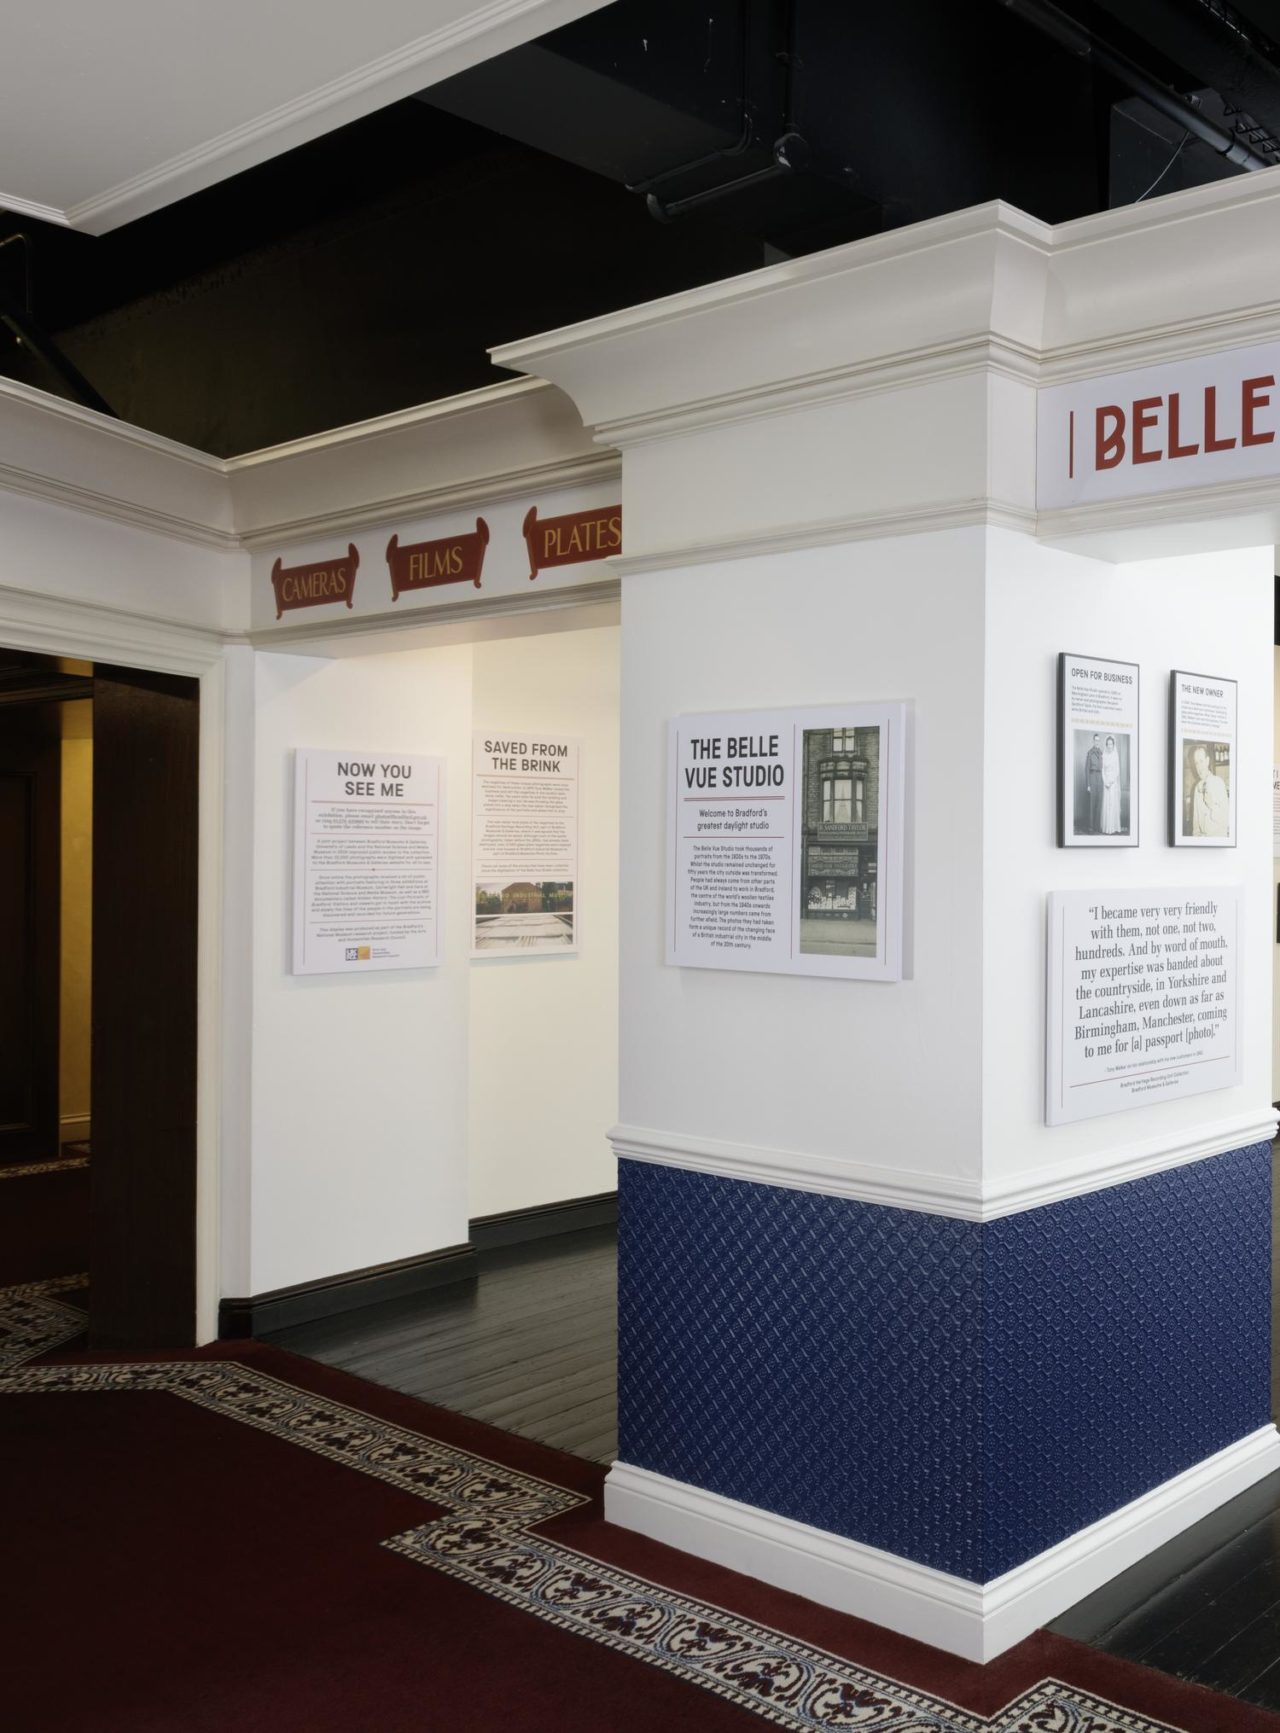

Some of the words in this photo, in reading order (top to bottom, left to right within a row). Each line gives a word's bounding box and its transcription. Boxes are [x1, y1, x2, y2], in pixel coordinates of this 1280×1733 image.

[1097, 377, 1274, 468] BELLE
[543, 516, 622, 558] PLATES
[409, 546, 463, 582] FILMS
[282, 567, 346, 602] CAMERAS
[1071, 668, 1089, 679] OPEN
[1090, 670, 1102, 681] FOR
[1103, 672, 1133, 685] BUSINESS
[1181, 684, 1192, 693] THE
[1193, 686, 1204, 695] NEW
[1205, 687, 1224, 698] OWNER
[484, 740, 527, 754] SAVED
[532, 744, 568, 757] FROM
[690, 738, 721, 760] THE
[727, 735, 779, 758] BELLE
[337, 762, 375, 777] NOW
[380, 764, 412, 779] YOU
[492, 758, 517, 771] THE
[522, 759, 560, 772] BRINK
[685, 767, 717, 789] VUE
[722, 764, 784, 787] STUDIO
[345, 782, 375, 796] SEE
[381, 783, 404, 797] ME
[699, 809, 725, 818] Welcome
[727, 809, 734, 818] to
[735, 808, 767, 817] Bradford’s
[697, 821, 722, 831] greatest
[724, 821, 748, 831] daylight
[750, 821, 769, 830] studio
[1101, 906, 1137, 920] became
[1141, 907, 1161, 920] very
[1163, 905, 1183, 919] very
[1185, 901, 1218, 918] friendly
[1091, 925, 1113, 940] with
[1117, 924, 1143, 938] them,
[1145, 924, 1160, 936] not
[1163, 923, 1181, 935] one,
[1183, 922, 1196, 934] not
[1199, 921, 1216, 933] two,
[1075, 945, 1125, 960] hundreds.
[1128, 941, 1148, 957] And
[1151, 941, 1162, 957] by
[1165, 938, 1187, 952] word
[1189, 937, 1199, 951] of
[1081, 968, 1097, 983] my
[1100, 962, 1144, 980] expertise
[1147, 961, 1164, 973] was
[1166, 954, 1198, 971] banded
[1200, 954, 1223, 968] about
[1076, 985, 1092, 1000] the
[1094, 979, 1153, 998] countryside,
[1156, 977, 1165, 991] in
[1168, 972, 1209, 989] Yorkshire
[1211, 970, 1227, 983] and
[1079, 1001, 1136, 1019] Lancashire,
[1139, 997, 1160, 1012] even
[1162, 994, 1187, 1009] down
[1189, 993, 1199, 1004] as
[1201, 990, 1213, 1003] far
[1215, 990, 1224, 1000] as
[1197, 1007, 1227, 1024] coming
[1084, 1045, 1094, 1058] to
[1097, 1043, 1112, 1057] me
[1115, 1038, 1129, 1054] for
[1131, 1035, 1142, 1052] [a]
[1145, 1031, 1183, 1050] passport
